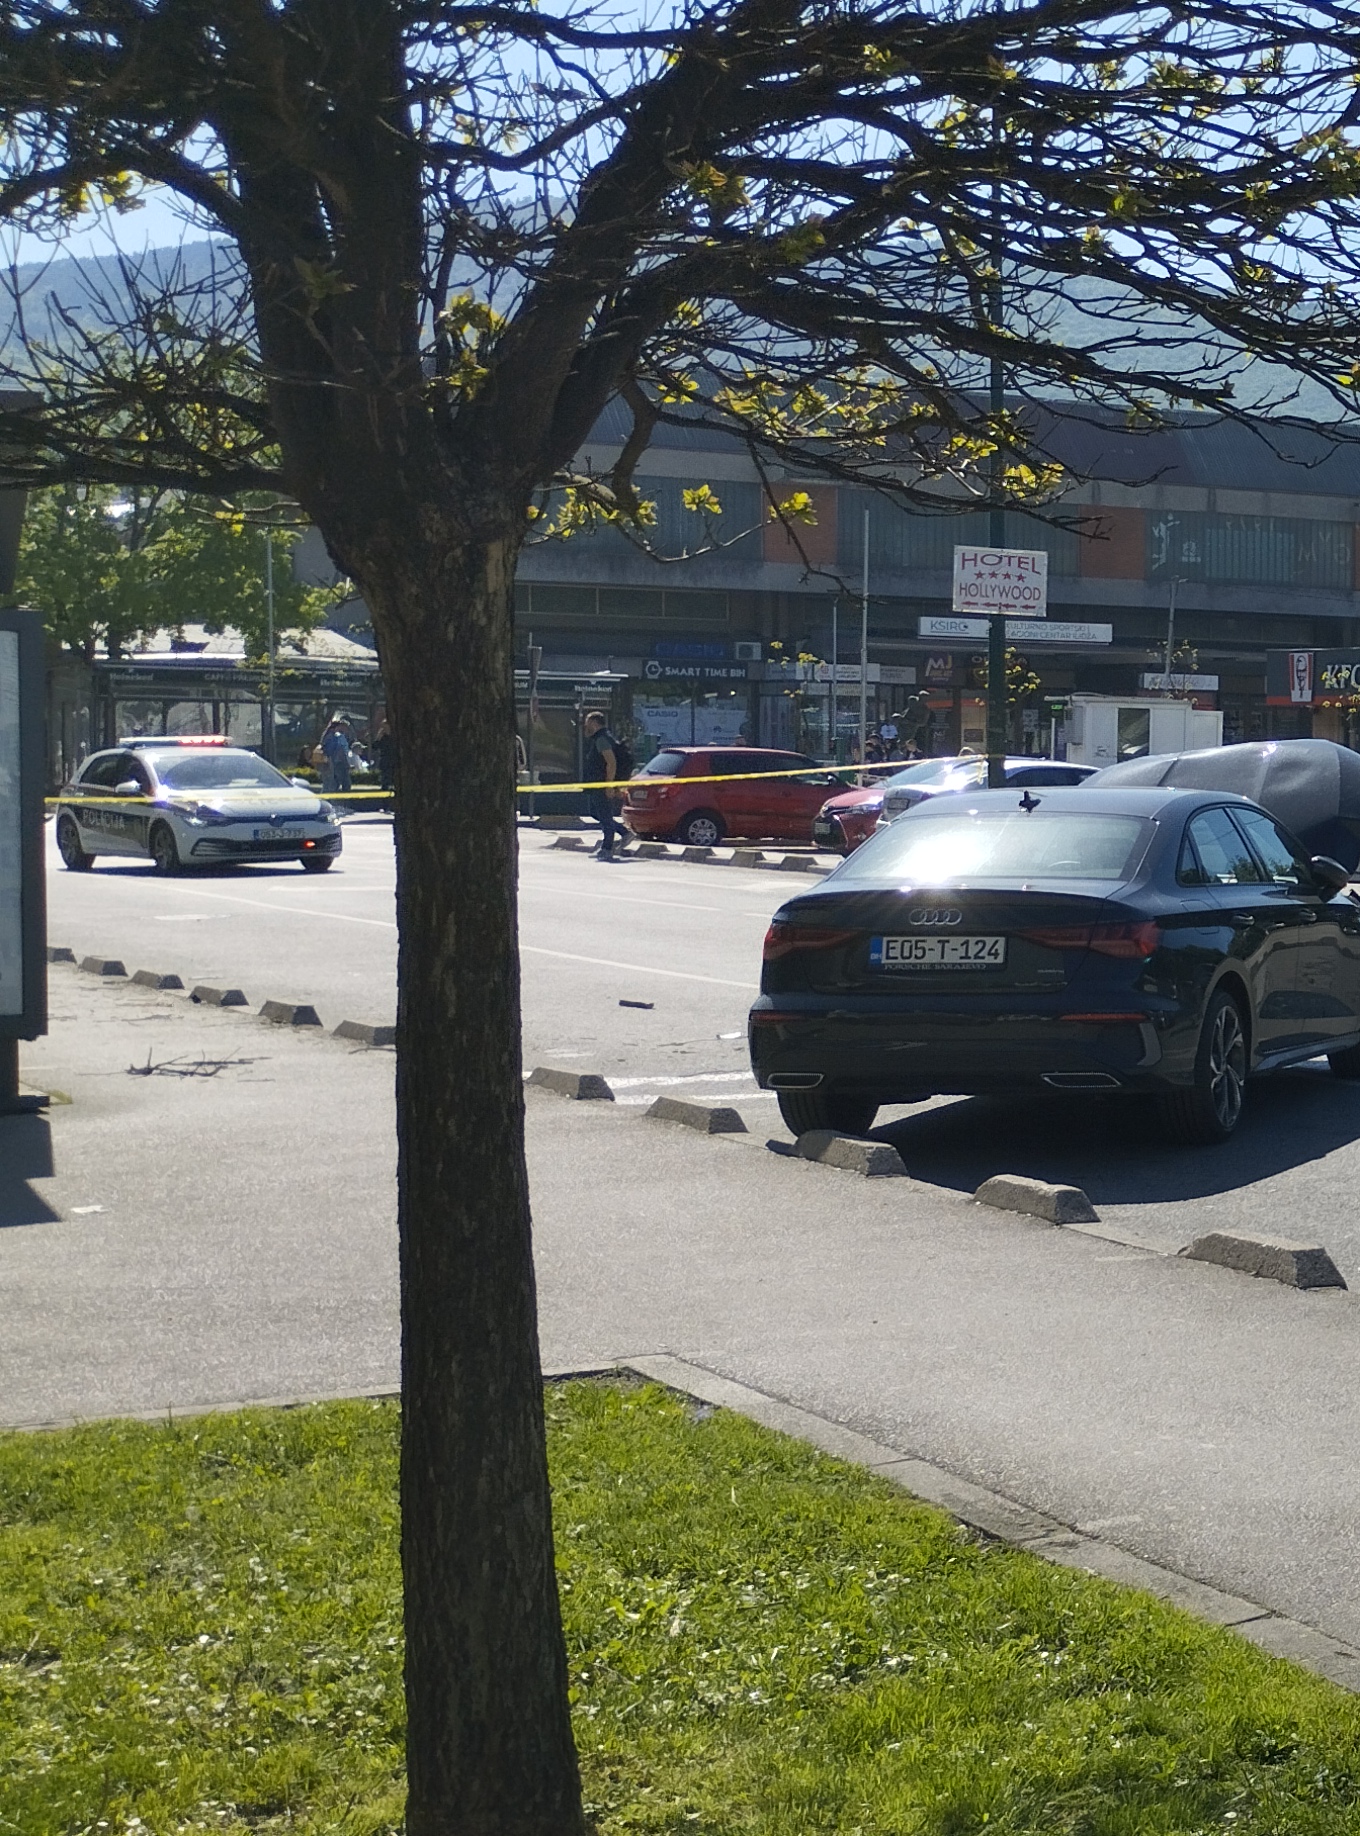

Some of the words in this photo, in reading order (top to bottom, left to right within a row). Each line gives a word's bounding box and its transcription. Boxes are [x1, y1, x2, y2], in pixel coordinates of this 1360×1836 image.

[961, 552, 1041, 575] HOTEL
[959, 582, 1041, 601] HOLLYWOOD
[665, 667, 700, 676] SMART
[704, 668, 727, 677] TIME
[730, 669, 746, 677] BIH
[574, 685, 612, 693] Heineken
[647, 710, 678, 718] CASIO
[885, 939, 1000, 961] E05-T-124
